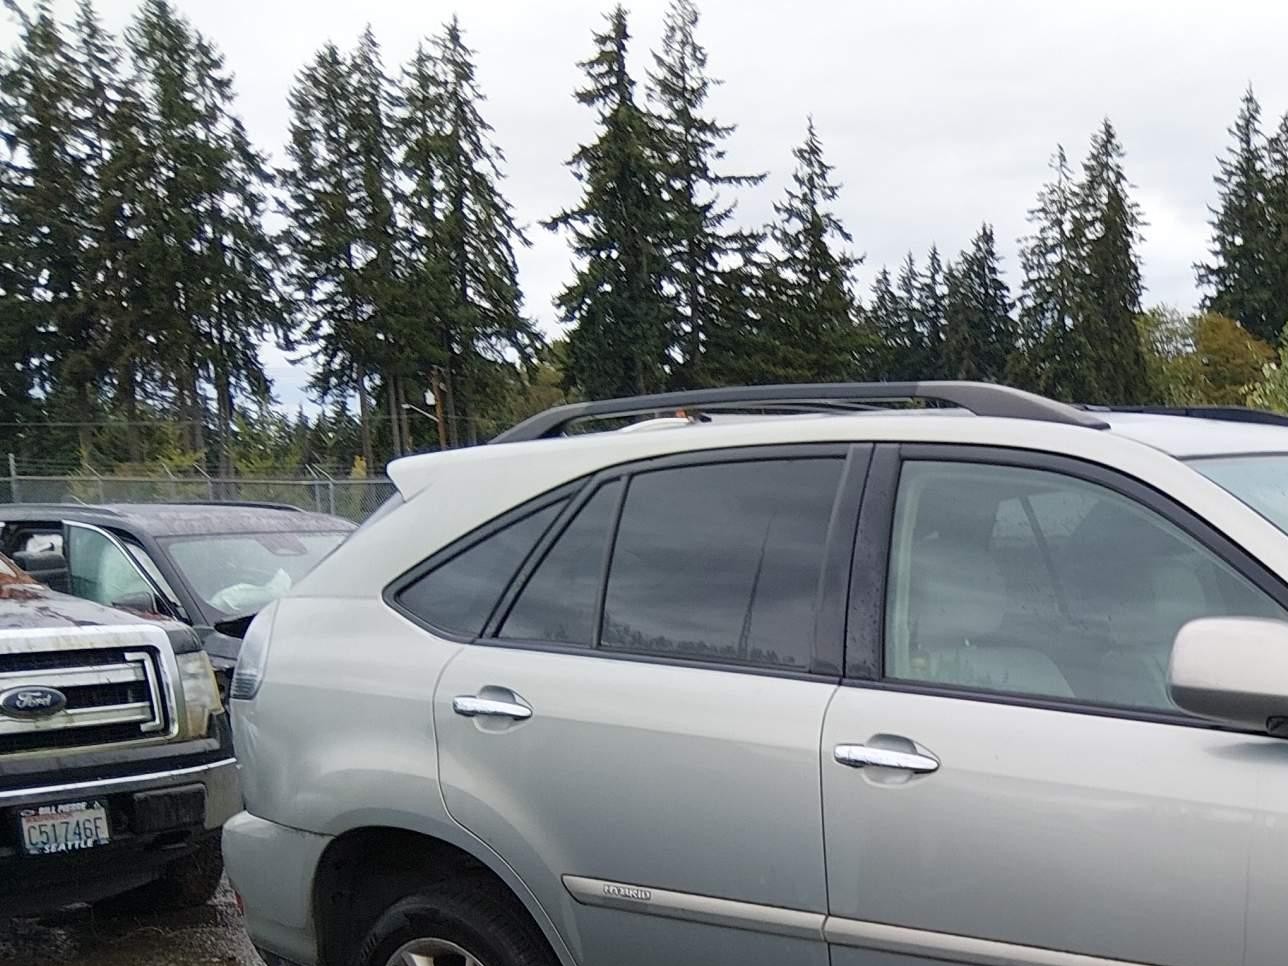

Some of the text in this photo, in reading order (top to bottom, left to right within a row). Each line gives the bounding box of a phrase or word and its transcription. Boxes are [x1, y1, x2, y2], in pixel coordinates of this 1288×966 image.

[16, 691, 52, 708] Ford
[43, 839, 94, 854] SEATTLE
[603, 885, 650, 900] HYBRID
